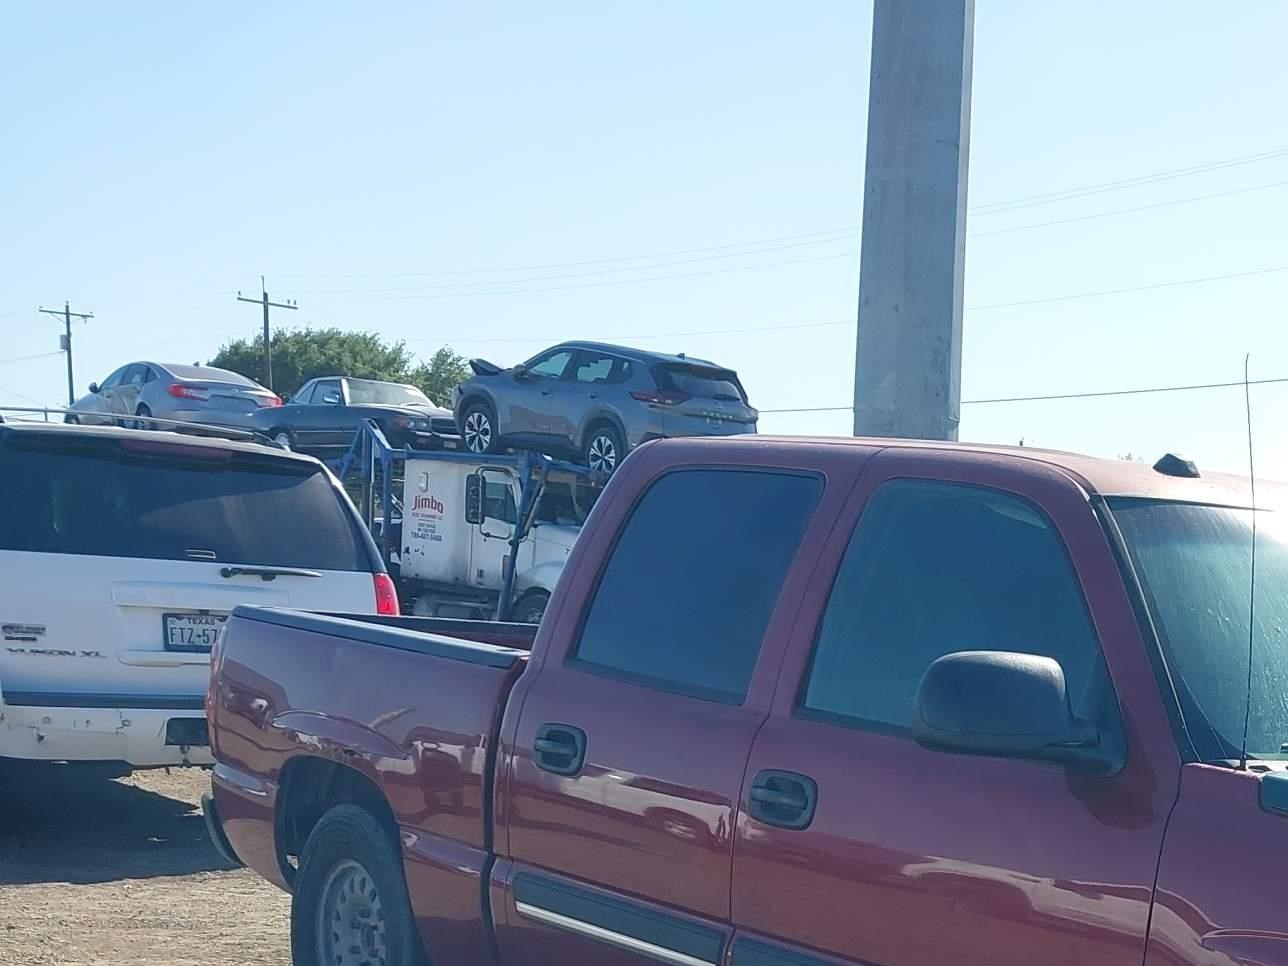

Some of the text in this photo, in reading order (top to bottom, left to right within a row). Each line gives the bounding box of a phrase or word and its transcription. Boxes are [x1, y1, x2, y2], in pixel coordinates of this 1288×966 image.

[411, 495, 444, 514] Jimbo
[187, 617, 216, 626] TEXAS
[5, 647, 108, 658] YUKON XL
